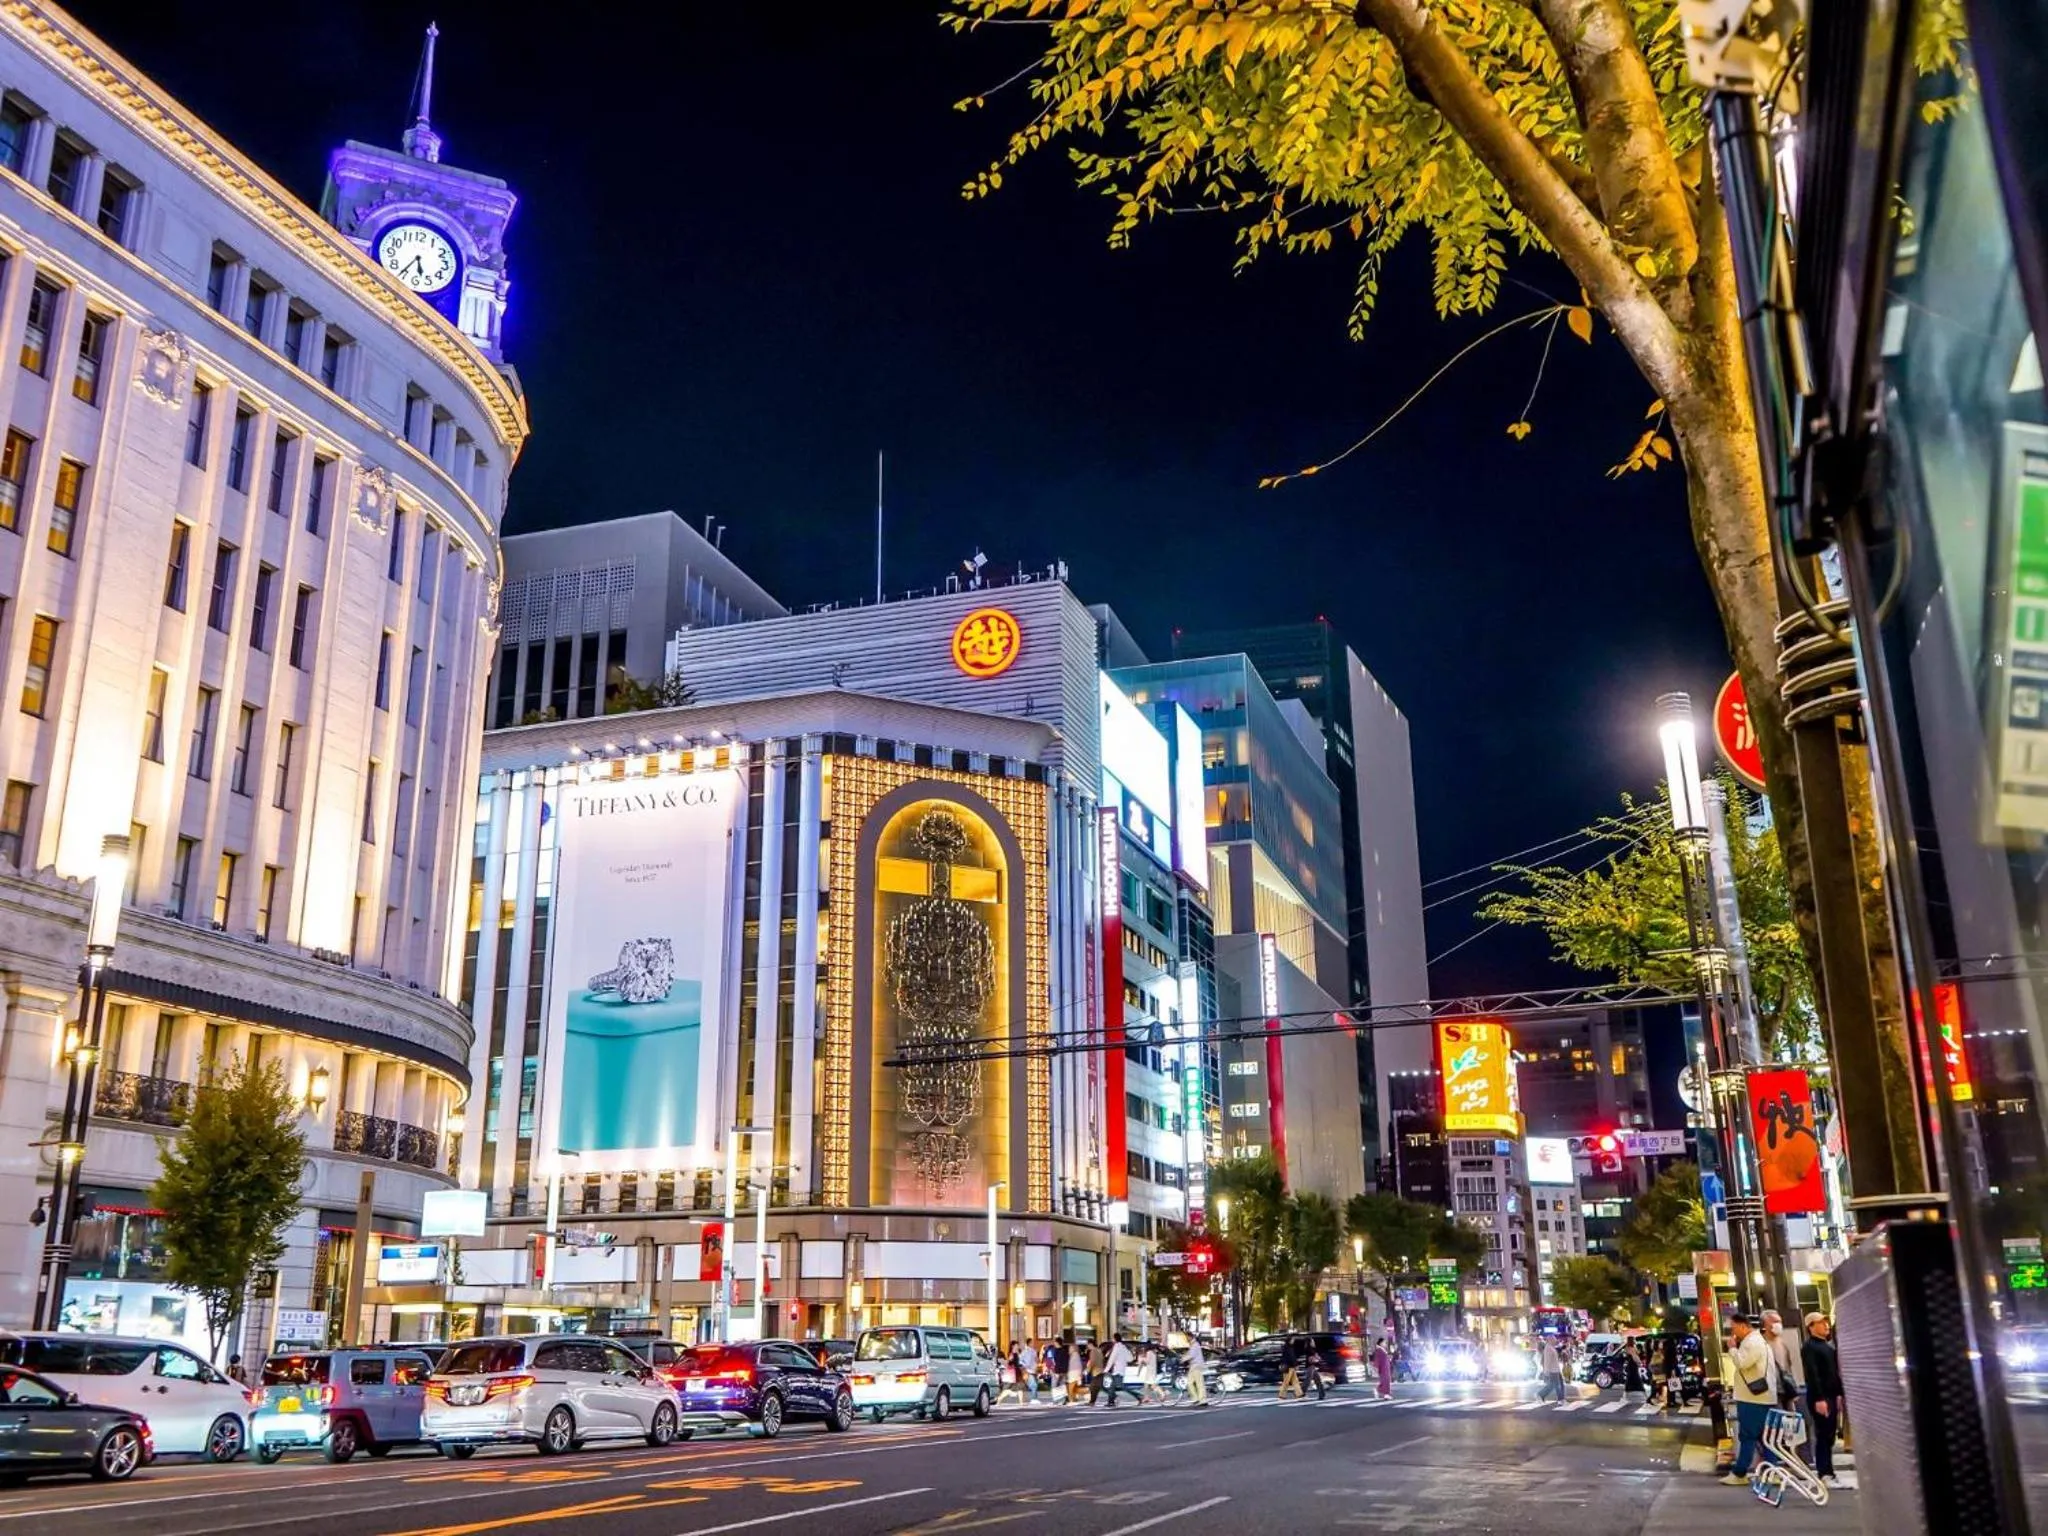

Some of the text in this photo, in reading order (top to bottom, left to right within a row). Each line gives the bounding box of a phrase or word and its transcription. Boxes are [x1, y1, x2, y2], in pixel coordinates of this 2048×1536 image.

[403, 231, 413, 242] 11
[415, 231, 427, 243] 12
[391, 237, 402, 249] 10
[430, 238, 435, 248] 1
[386, 246, 396, 258] 9
[437, 247, 446, 259] 2
[389, 258, 399, 270] 8
[440, 260, 449, 271] 3
[410, 275, 420, 286] 6
[424, 275, 433, 286] 5
[434, 270, 444, 280] 4
[1102, 812, 1118, 916] MITSUKOSHI
[1263, 938, 1278, 1016] MITSUKOSHI
[1444, 1025, 1488, 1042] S&B
[1628, 1135, 1681, 1148] 銀座四丁目
